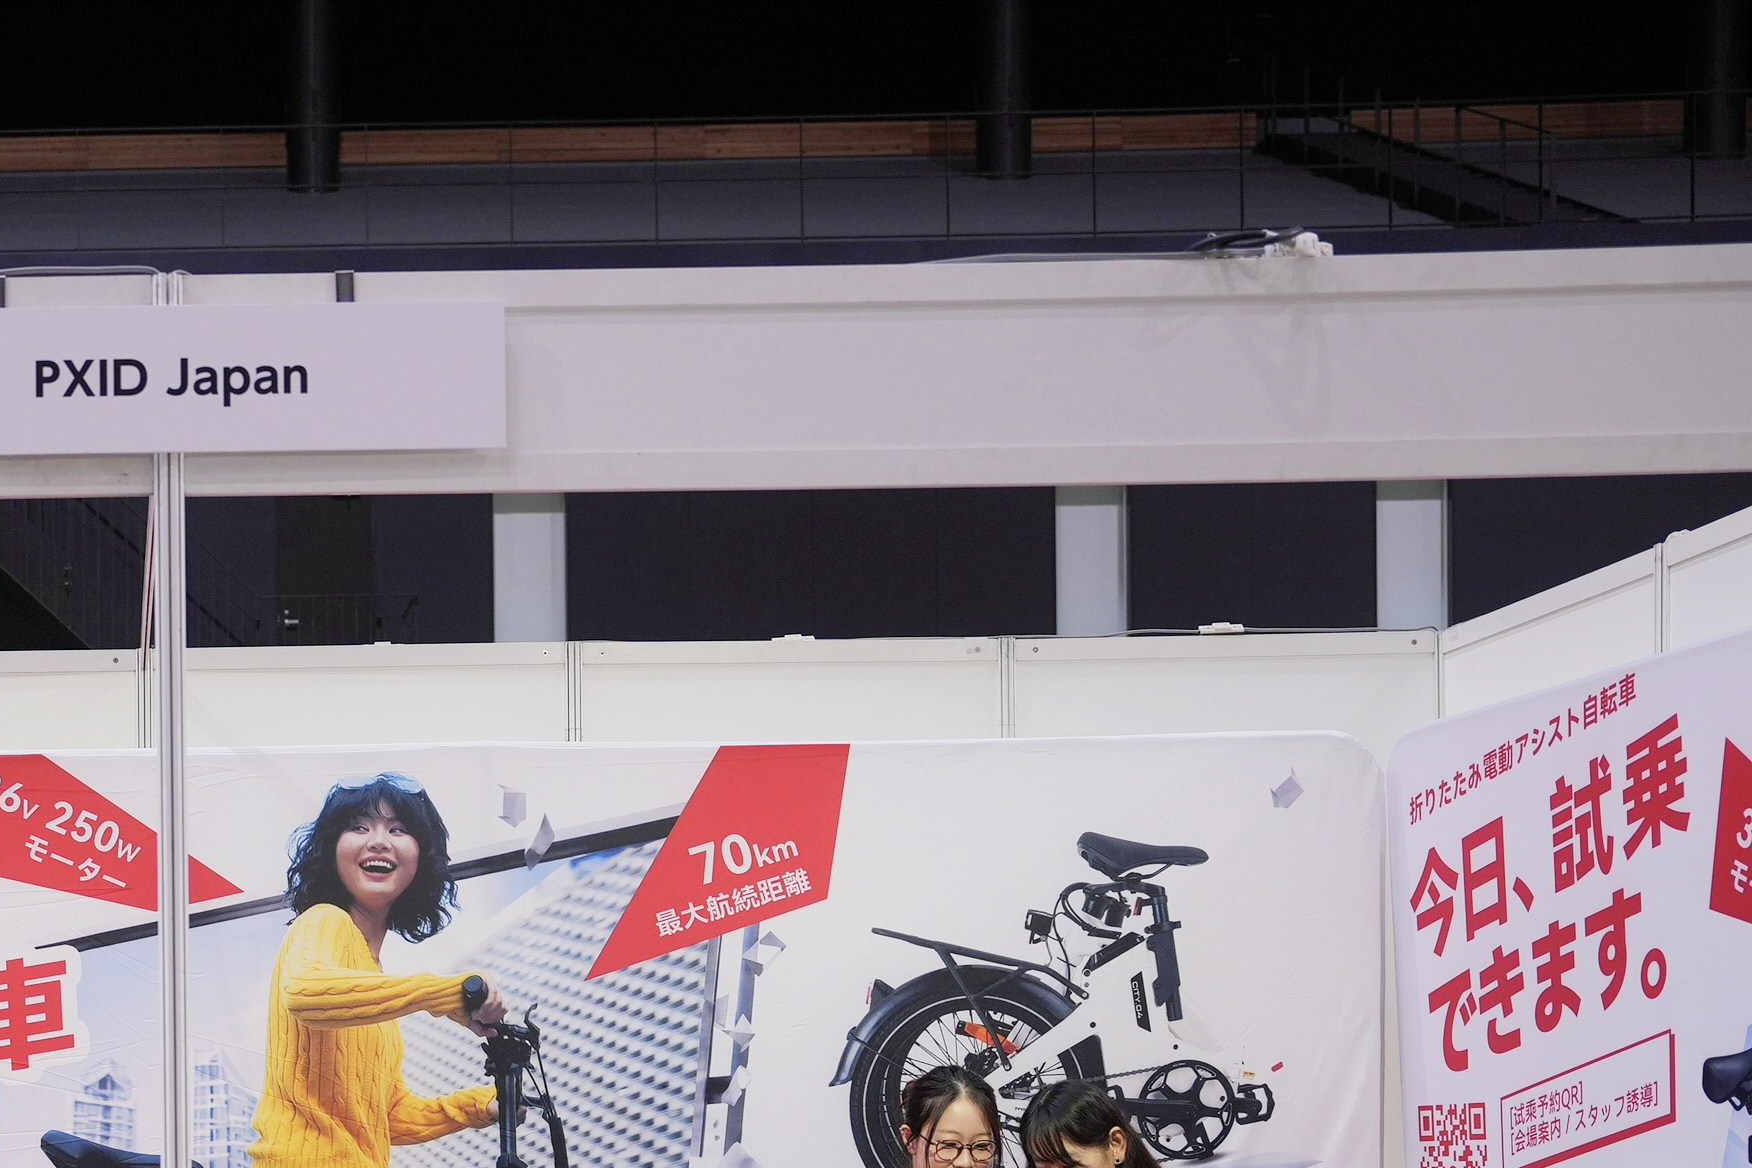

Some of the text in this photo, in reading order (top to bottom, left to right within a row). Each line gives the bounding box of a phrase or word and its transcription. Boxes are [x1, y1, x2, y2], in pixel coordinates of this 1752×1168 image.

[36, 357, 309, 407] PXID Japan
[1410, 673, 1637, 825] 折りたたみ電動アシスト自転車
[24, 834, 127, 888] モーター
[688, 833, 799, 885] 70km
[1410, 713, 1691, 957] 今日、試乗
[655, 867, 813, 938] 最大航続距離
[1730, 859, 1752, 894] モ
[1428, 887, 1668, 1073] できます。
